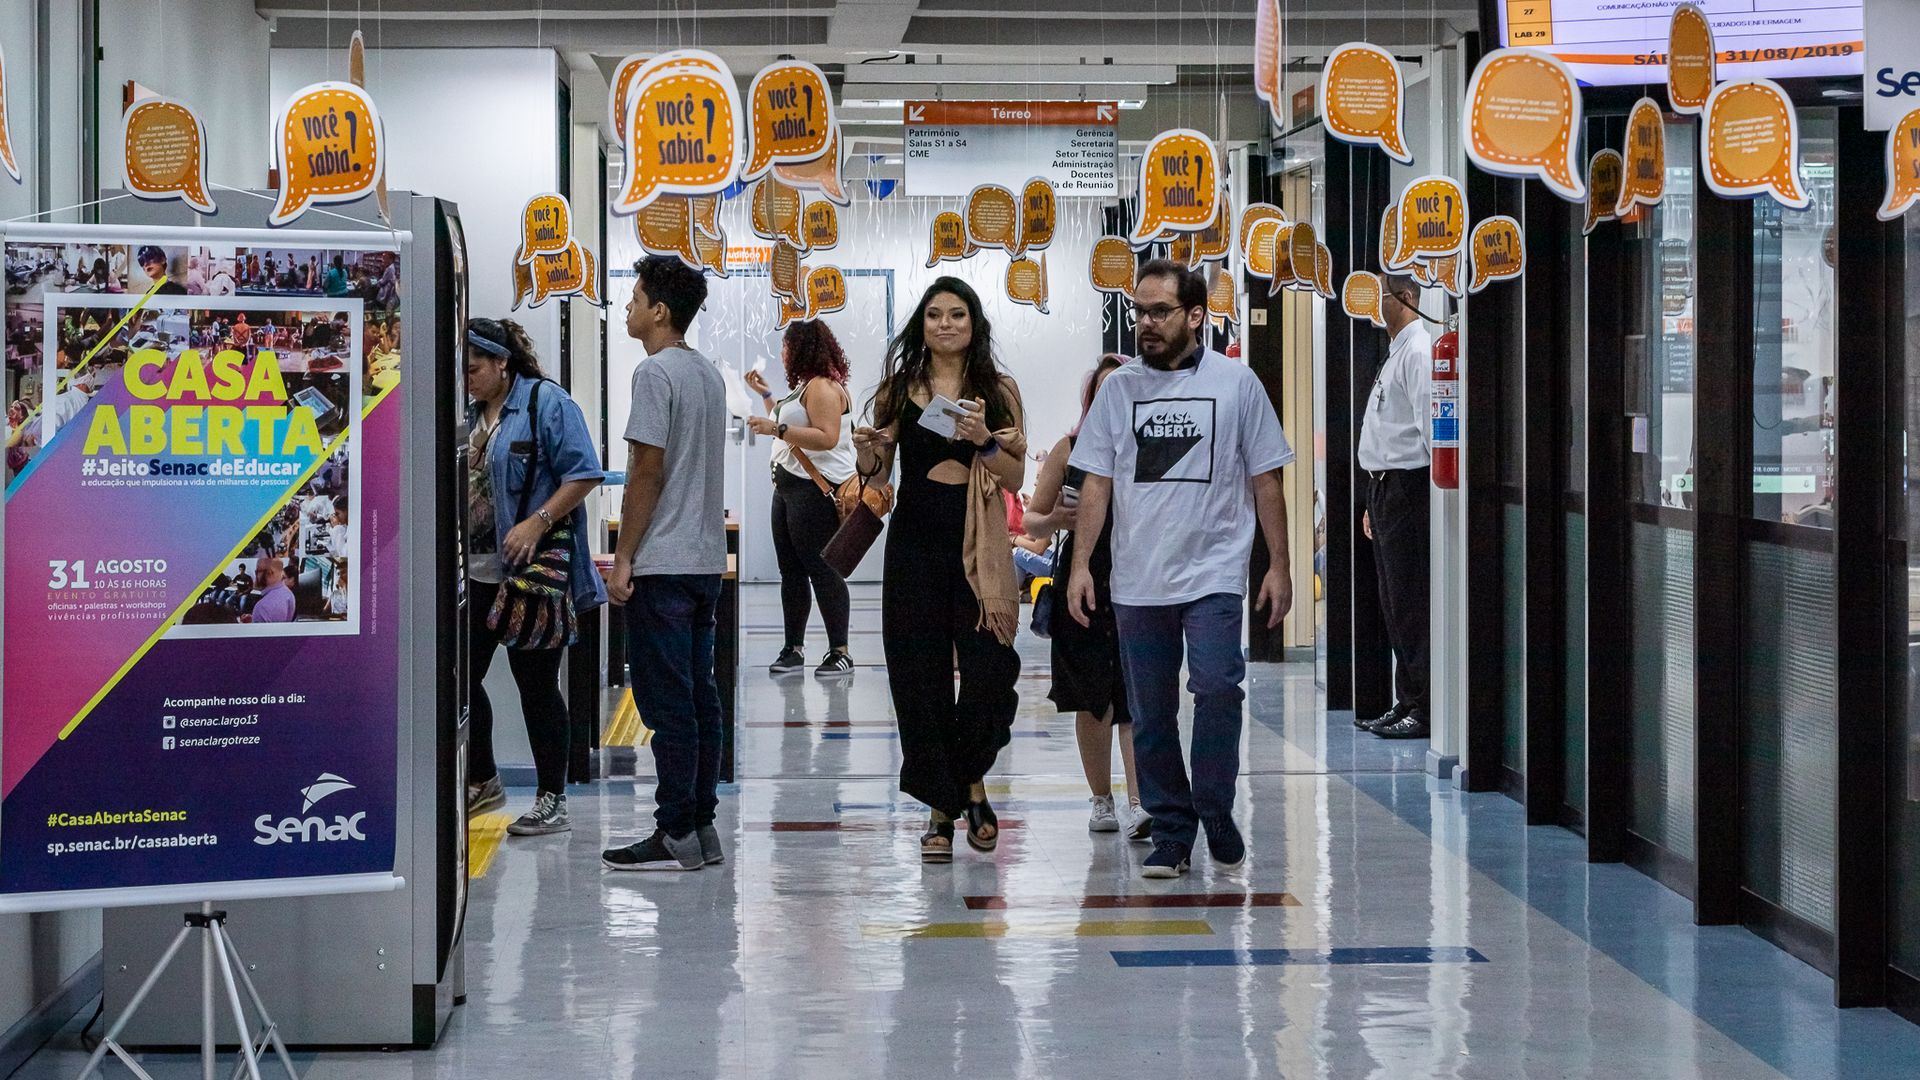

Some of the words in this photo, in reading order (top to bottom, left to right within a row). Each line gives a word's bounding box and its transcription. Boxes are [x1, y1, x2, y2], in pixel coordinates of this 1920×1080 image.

[1597, 2, 1652, 11] COMUNICAÇÃO
[1747, 18, 1802, 26] ENFERMAGEM
[1514, 31, 1532, 39] LAB
[1725, 44, 1854, 62] 31/08/2019
[768, 81, 799, 110] você
[656, 92, 695, 127] você
[991, 106, 1032, 119] Térreo
[302, 106, 339, 141] você
[909, 128, 960, 137] Patrimônio
[1076, 129, 1114, 137] Gerência
[909, 139, 932, 147] Salas
[935, 139, 945, 147] S1
[955, 139, 967, 147] S4
[1071, 139, 1114, 147] Secretaria
[909, 150, 930, 158] CME
[1055, 150, 1079, 158] Setor
[1081, 150, 1114, 158] Técnico
[1052, 160, 1114, 170] Administração
[1161, 150, 1189, 177] você
[1071, 170, 1114, 178] Docentes
[1062, 181, 1073, 189] de
[1076, 180, 1114, 189] Reunião
[1416, 192, 1440, 214] você
[533, 204, 551, 222] você
[1482, 229, 1502, 248] você
[123, 348, 288, 401] CASA
[1152, 411, 1195, 425] CASA
[81, 404, 324, 456] ABERTA
[1143, 423, 1204, 438] ABERTA
[81, 458, 302, 477] #JeitoSenacdeEducar
[88, 478, 124, 488] educação
[127, 480, 140, 488] que
[142, 478, 182, 488] impulsiona
[190, 478, 204, 487] vida
[206, 478, 216, 487] de
[217, 478, 248, 487] milhares
[250, 478, 259, 487] de
[261, 479, 290, 488] pessoas
[95, 559, 167, 574] AGOSTO
[48, 560, 90, 590] 31
[94, 580, 105, 589] 10
[107, 577, 119, 589] ÀS
[121, 580, 132, 589] 16
[134, 579, 167, 588] HORAS
[48, 591, 96, 600] EVENTO
[104, 590, 167, 600] GRATUITO
[48, 602, 77, 611] oficinas
[84, 601, 118, 613] palestras
[125, 600, 167, 611] workshops
[48, 612, 96, 621] vivências
[101, 611, 167, 621] profissionais
[163, 696, 226, 708] Acompanhe
[229, 695, 258, 706] nosso
[261, 694, 276, 704] dia
[287, 693, 306, 703] dia:
[180, 715, 259, 728] @senac.largo13
[179, 735, 260, 748] senaclargotreze
[47, 809, 187, 827] #CasaAbertaSenac
[253, 811, 366, 845] Senac
[47, 833, 218, 856] sp.senac.br/casaaberta
